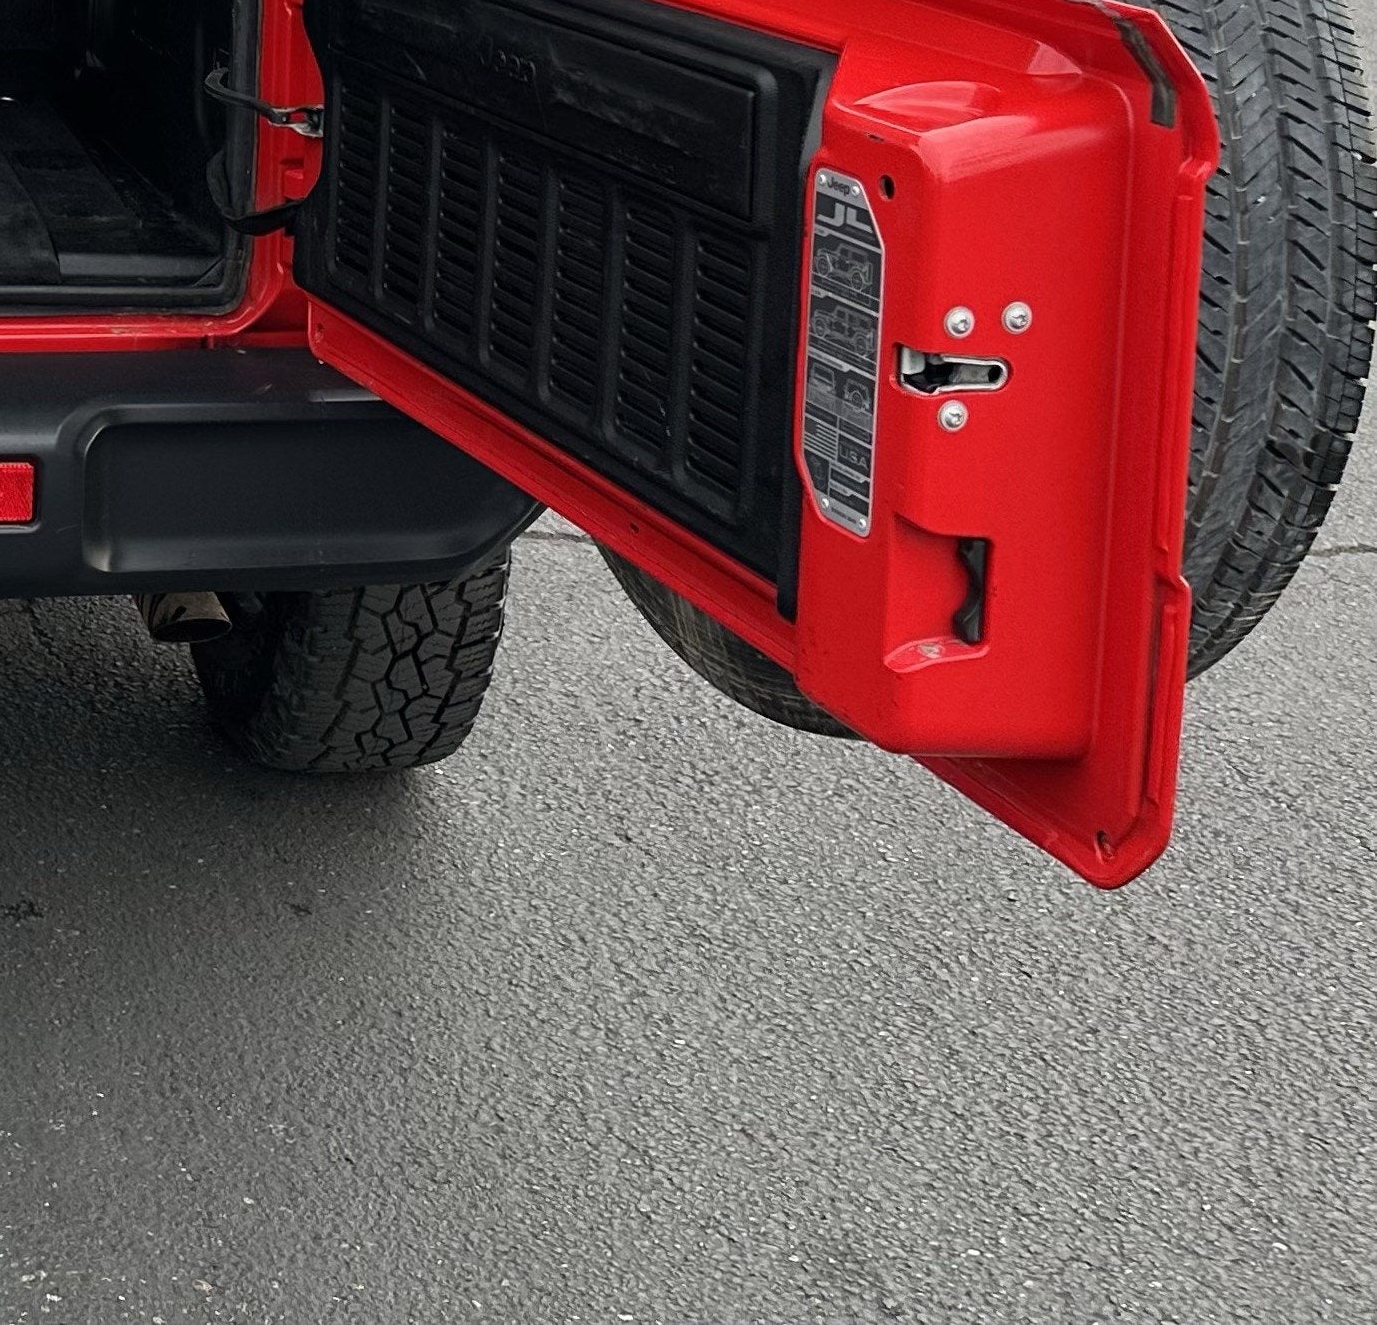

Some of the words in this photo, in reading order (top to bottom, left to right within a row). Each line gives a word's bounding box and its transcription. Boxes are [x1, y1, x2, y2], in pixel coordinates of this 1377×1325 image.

[827, 177, 851, 196] Jeep
[816, 202, 874, 234] JL
[839, 443, 869, 471] USA
